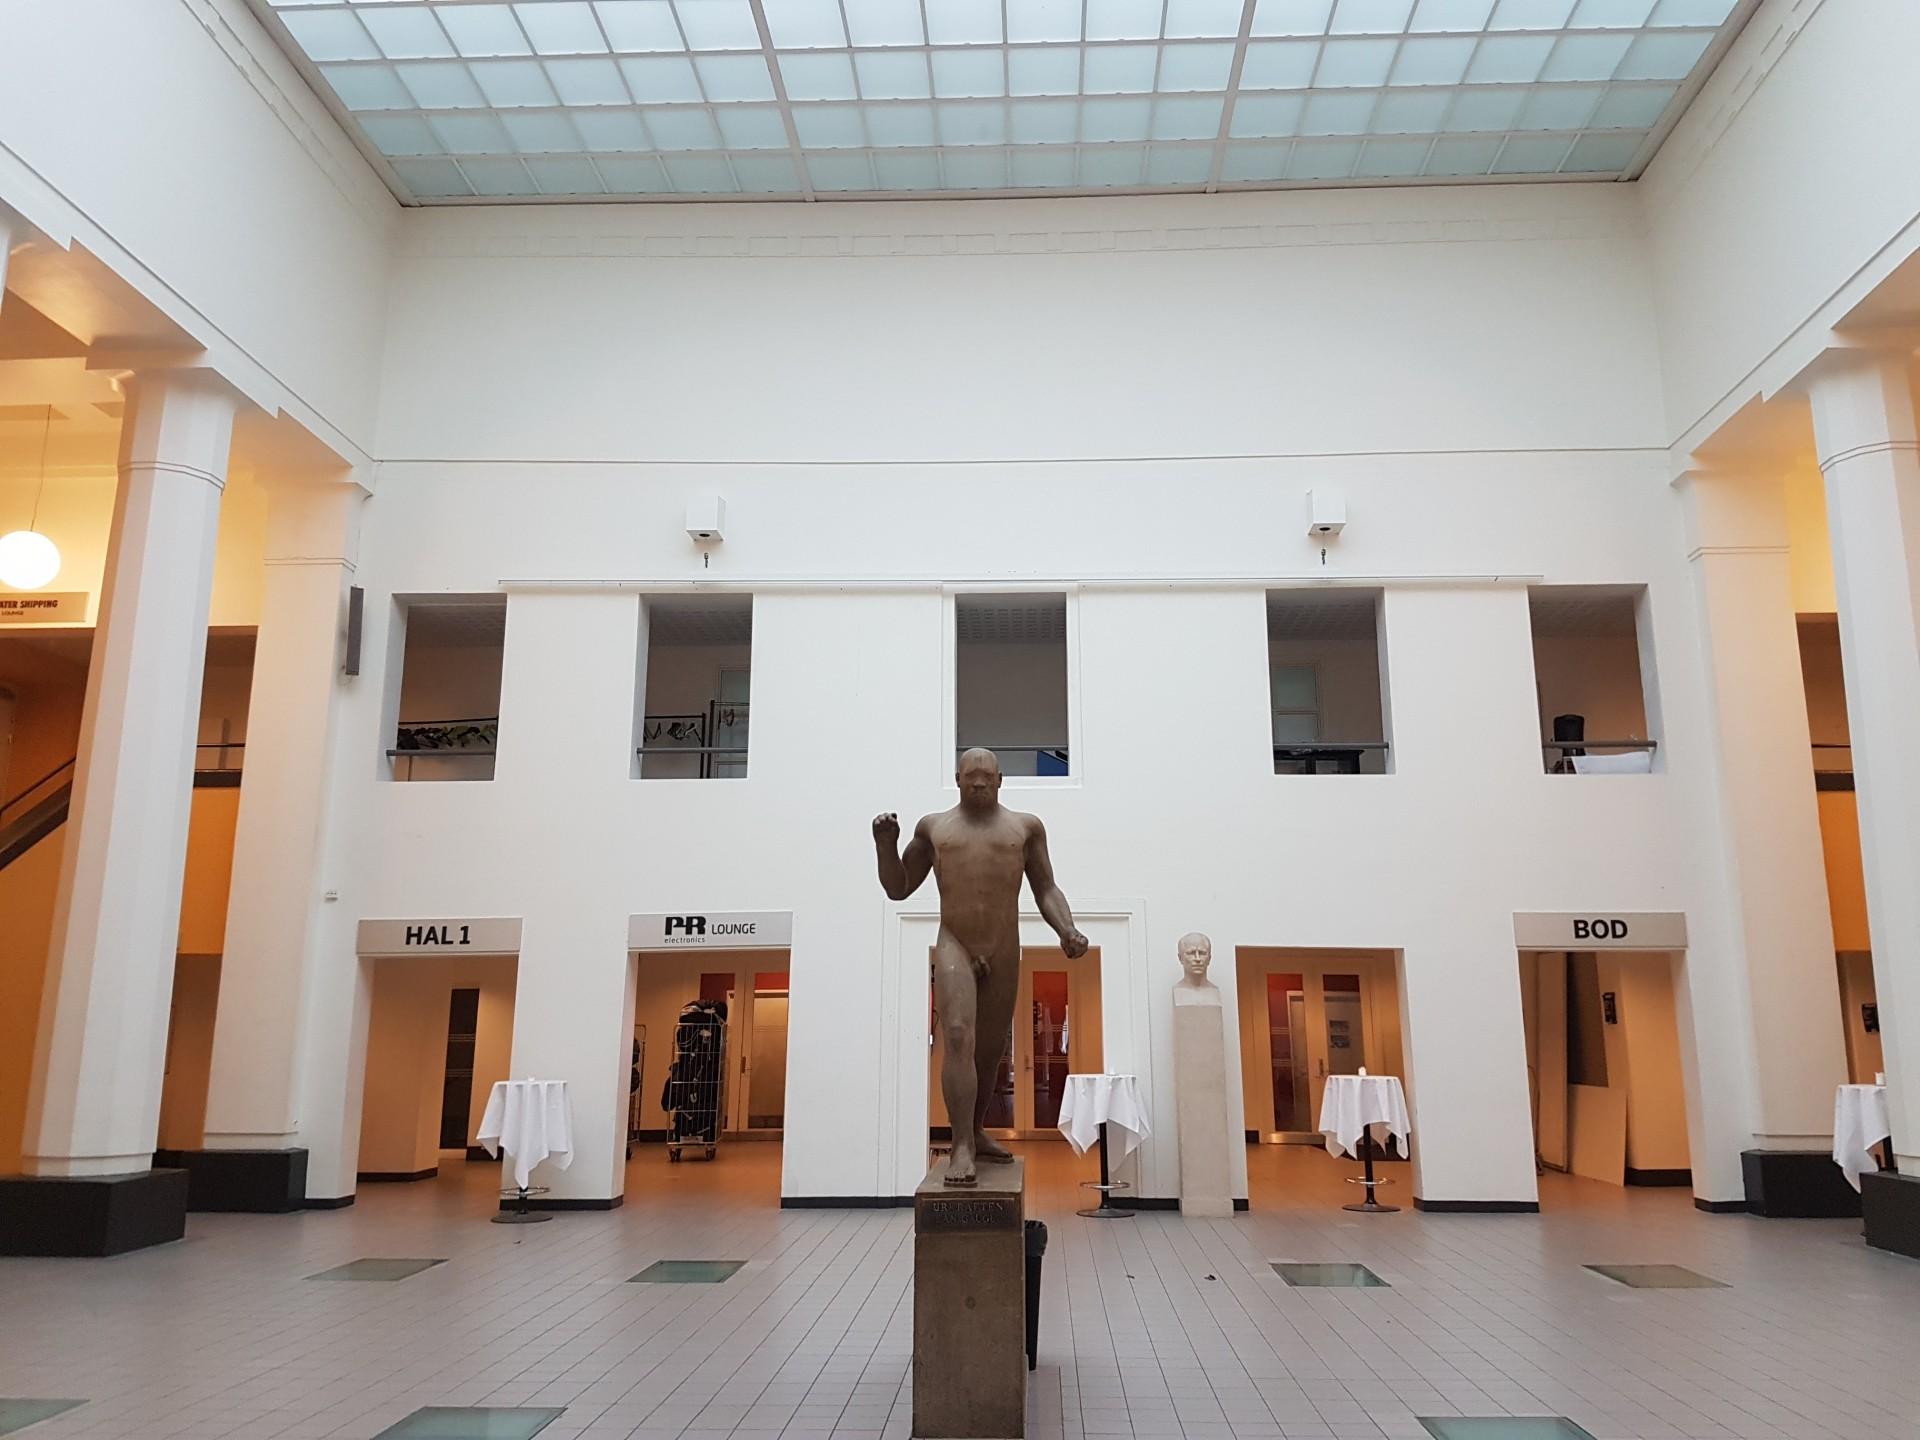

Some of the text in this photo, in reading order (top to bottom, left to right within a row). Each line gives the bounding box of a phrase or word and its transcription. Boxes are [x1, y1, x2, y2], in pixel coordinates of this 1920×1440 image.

[20, 600, 58, 608] SHIPPING
[405, 925, 471, 945] HAL 1
[664, 916, 757, 935] PR LOUNGE
[1573, 919, 1628, 939] BOD
